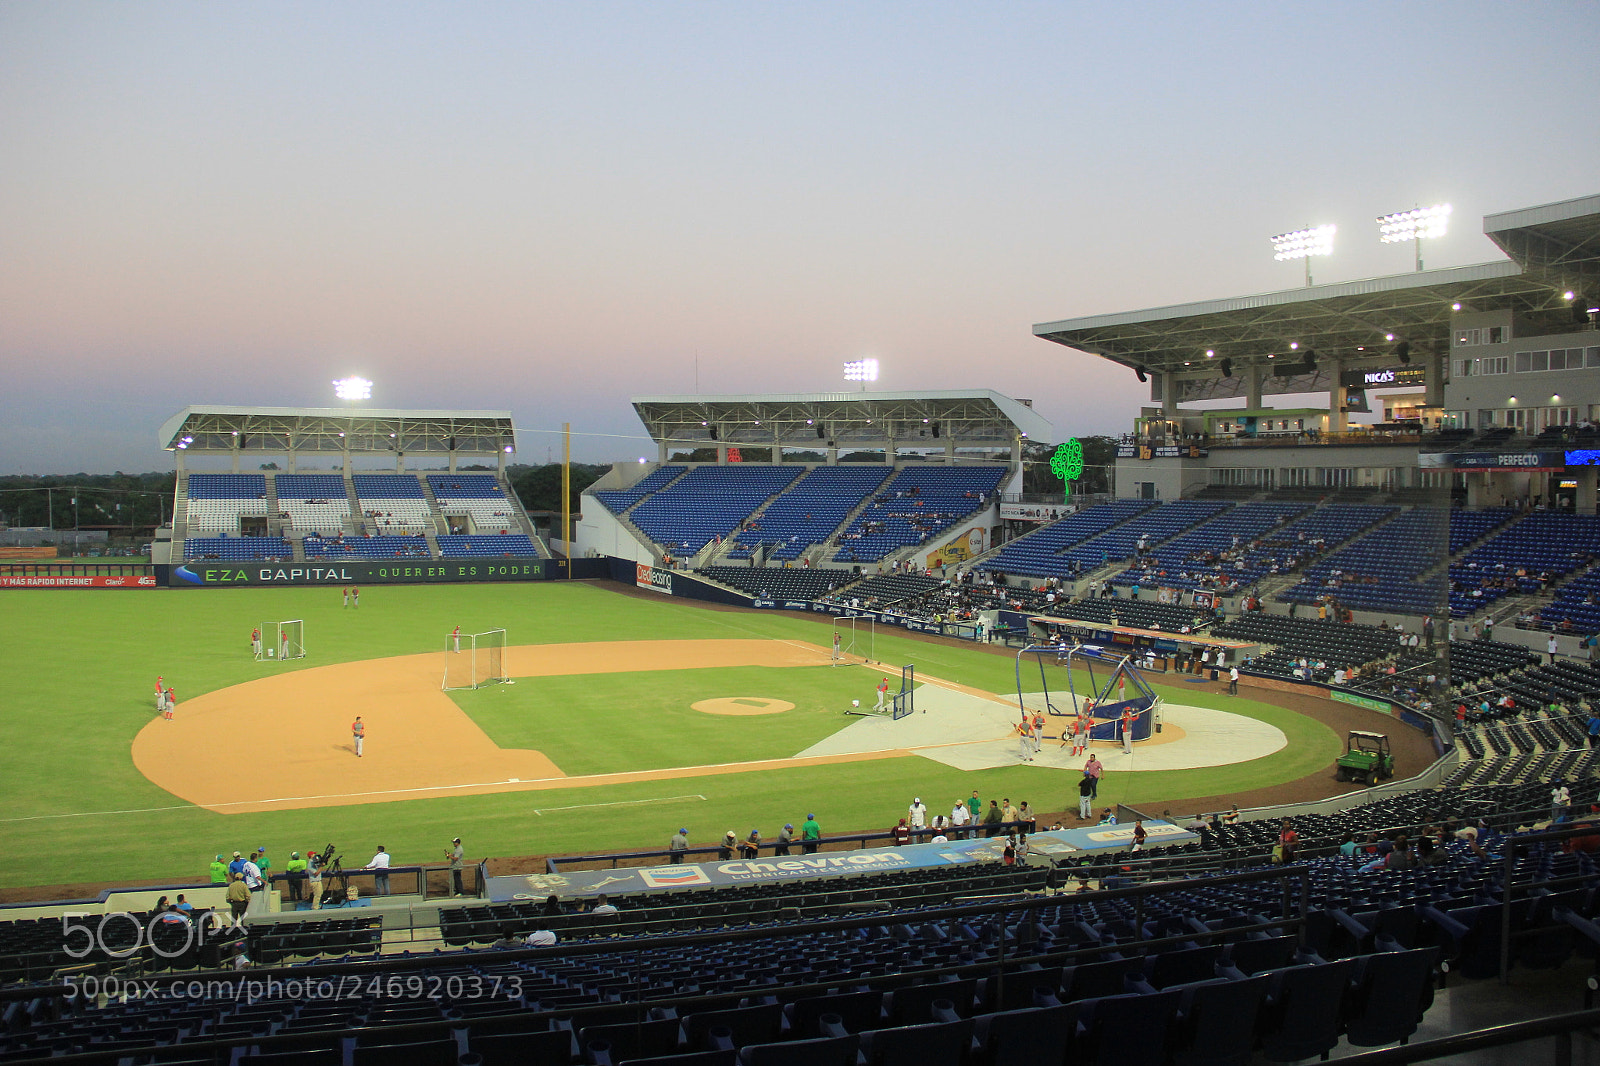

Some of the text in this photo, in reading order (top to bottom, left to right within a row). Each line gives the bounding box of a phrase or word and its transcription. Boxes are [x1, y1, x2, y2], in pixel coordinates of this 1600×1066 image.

[1364, 370, 1394, 383] NICA'S
[1498, 454, 1539, 466] PERFECTO
[205, 568, 353, 582] EZA CAPITAL
[379, 565, 541, 577] QUERER ES PODER
[10, 577, 26, 585] MÁS
[28, 577, 52, 585] RÁPIDO
[105, 577, 125, 585] Claro
[717, 852, 905, 875] Chevron
[842, 860, 911, 870] PREMIUM
[732, 867, 838, 880] LUBRICANTES
